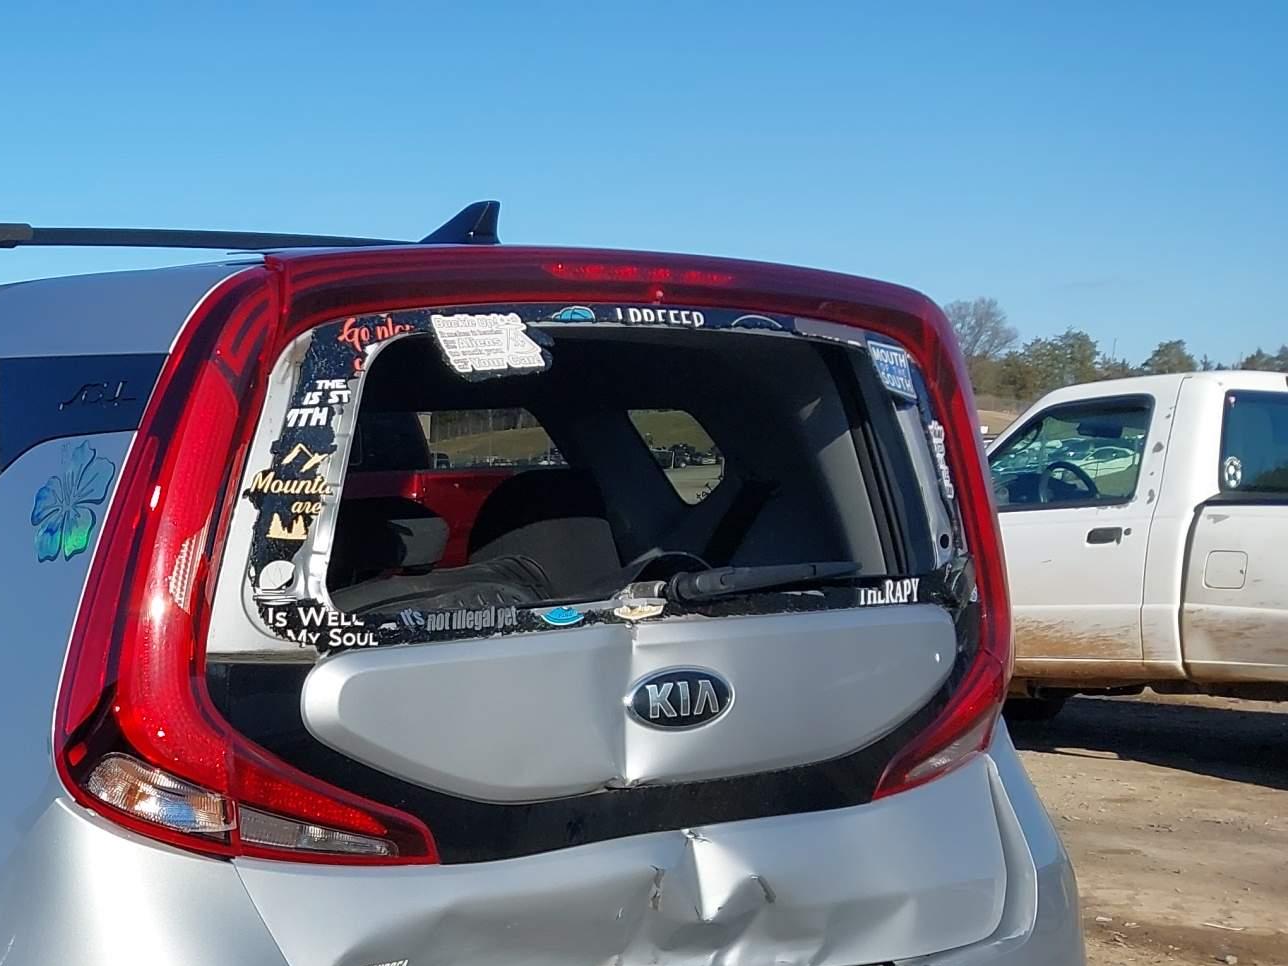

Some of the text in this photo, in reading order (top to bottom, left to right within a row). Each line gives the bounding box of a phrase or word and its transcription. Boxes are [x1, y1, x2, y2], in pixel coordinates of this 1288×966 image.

[871, 346, 907, 368] MOUTH
[315, 379, 347, 390] THE
[881, 371, 913, 391] SOUTH
[291, 501, 322, 514] are
[645, 679, 720, 719] KIA
